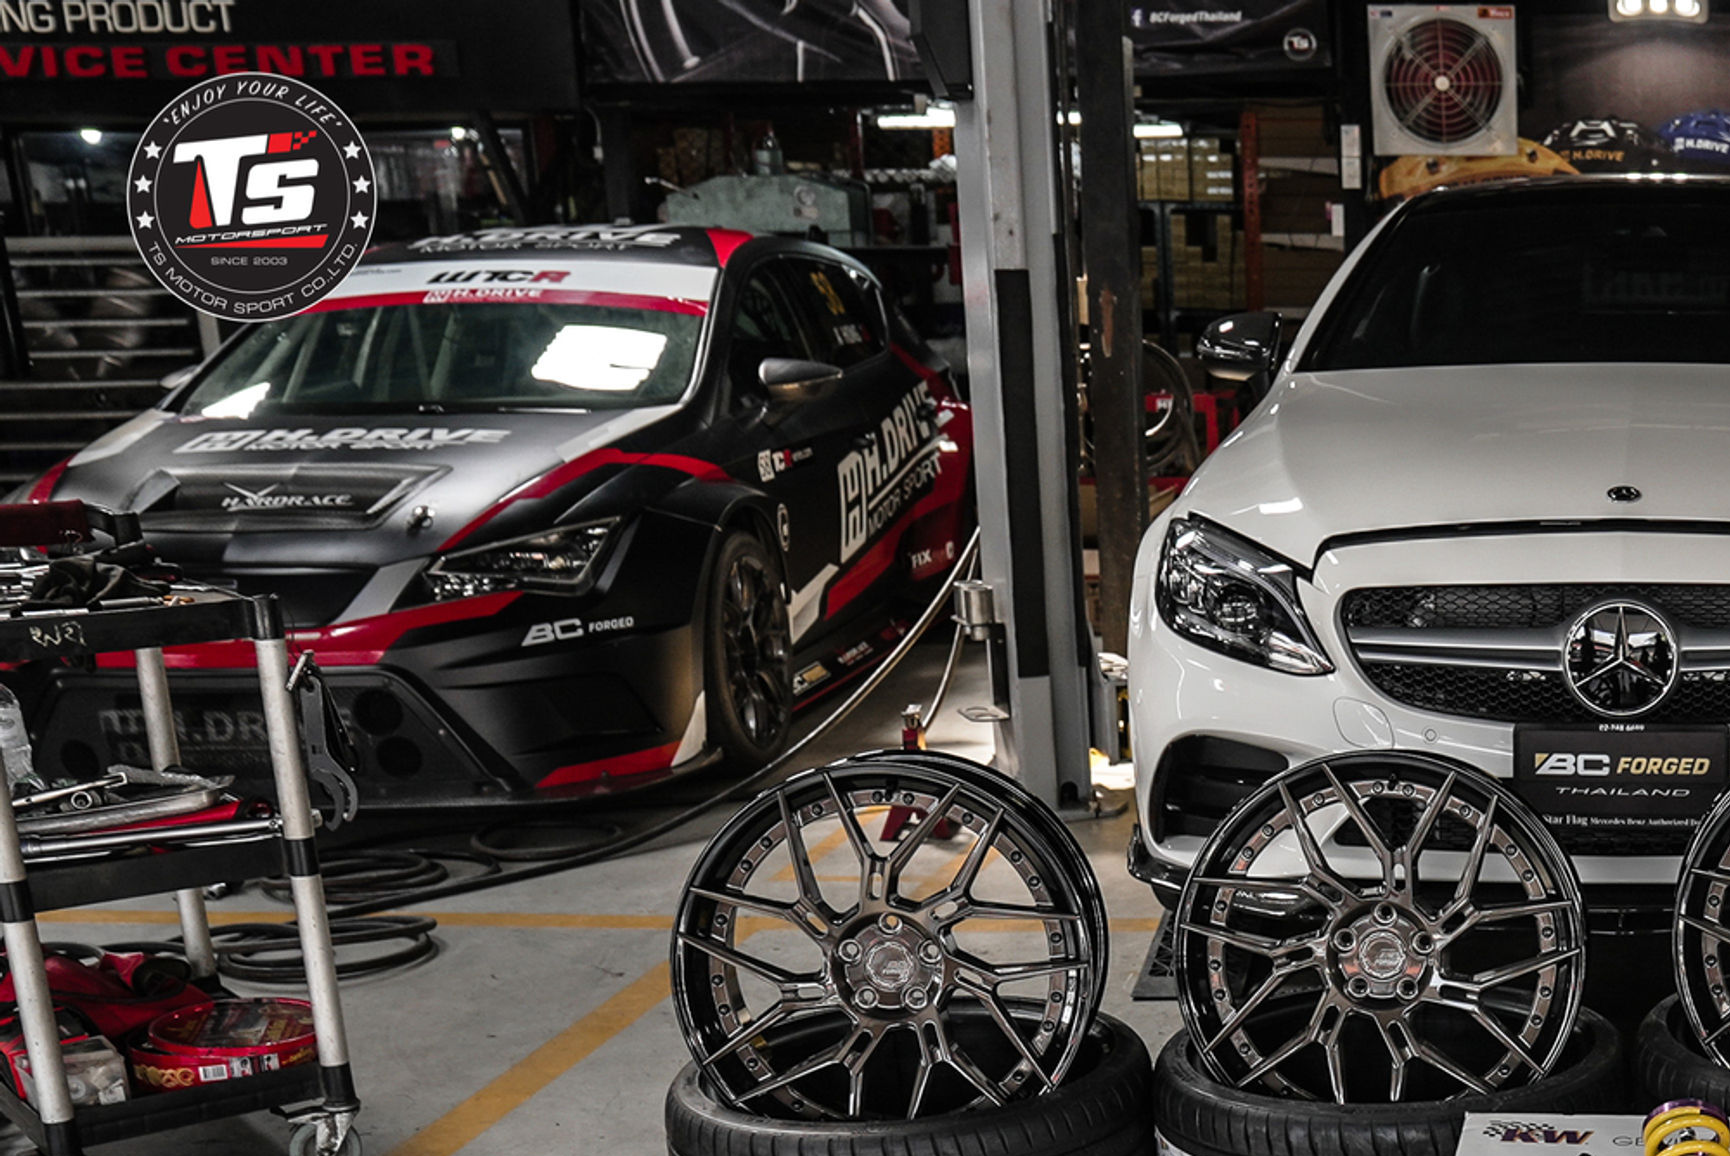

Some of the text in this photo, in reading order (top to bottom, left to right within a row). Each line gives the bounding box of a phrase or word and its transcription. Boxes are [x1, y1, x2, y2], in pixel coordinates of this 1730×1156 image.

[63, 0, 235, 33] PRODUCT
[165, 44, 434, 77] CENTER
[865, 380, 938, 496] H.DRIVE
[222, 492, 353, 509] HARDRACE
[521, 615, 635, 647] BC FORGED
[1535, 753, 1711, 776] BC FORGED
[1555, 787, 1691, 798] THAILAND
[1566, 814, 1588, 827] Flag
[1590, 816, 1625, 826] Mercedes
[1500, 1129, 1595, 1146] KW
